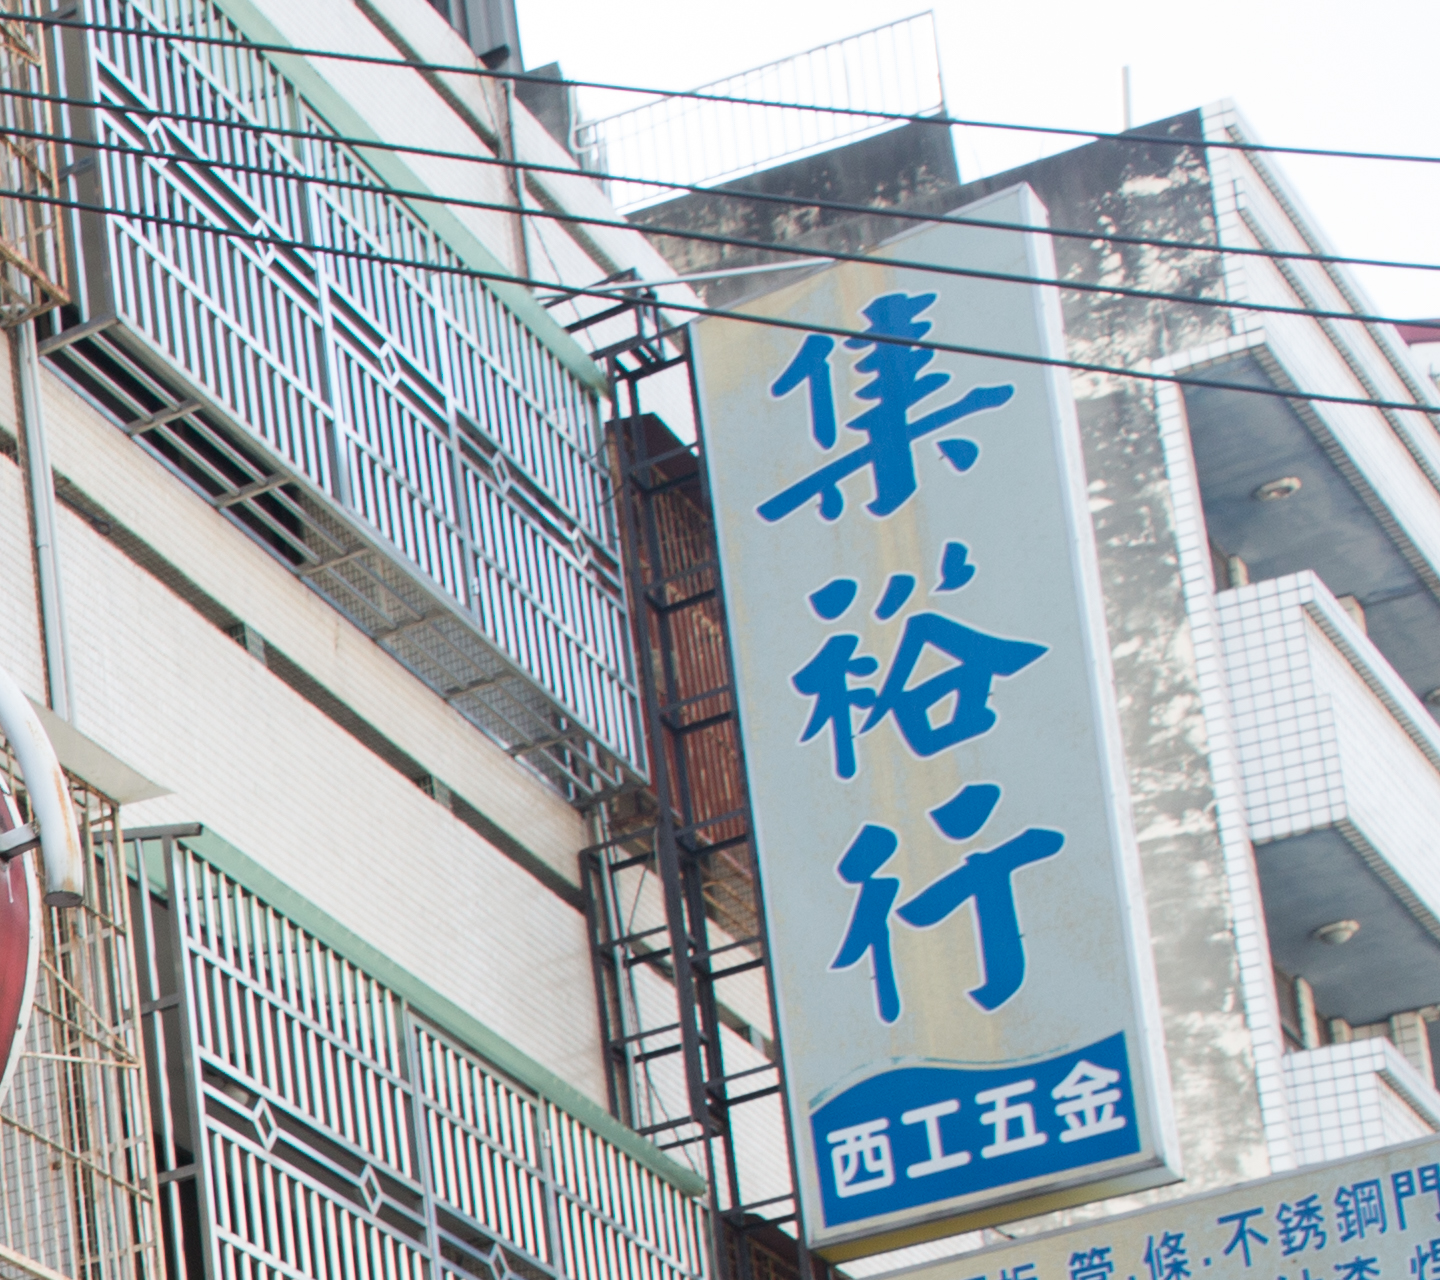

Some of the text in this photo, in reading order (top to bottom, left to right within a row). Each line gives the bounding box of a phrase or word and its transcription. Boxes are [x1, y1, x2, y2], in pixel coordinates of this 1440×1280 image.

[755, 290, 1066, 1024] 集裕行
[826, 1060, 1126, 1198] 西工五金
